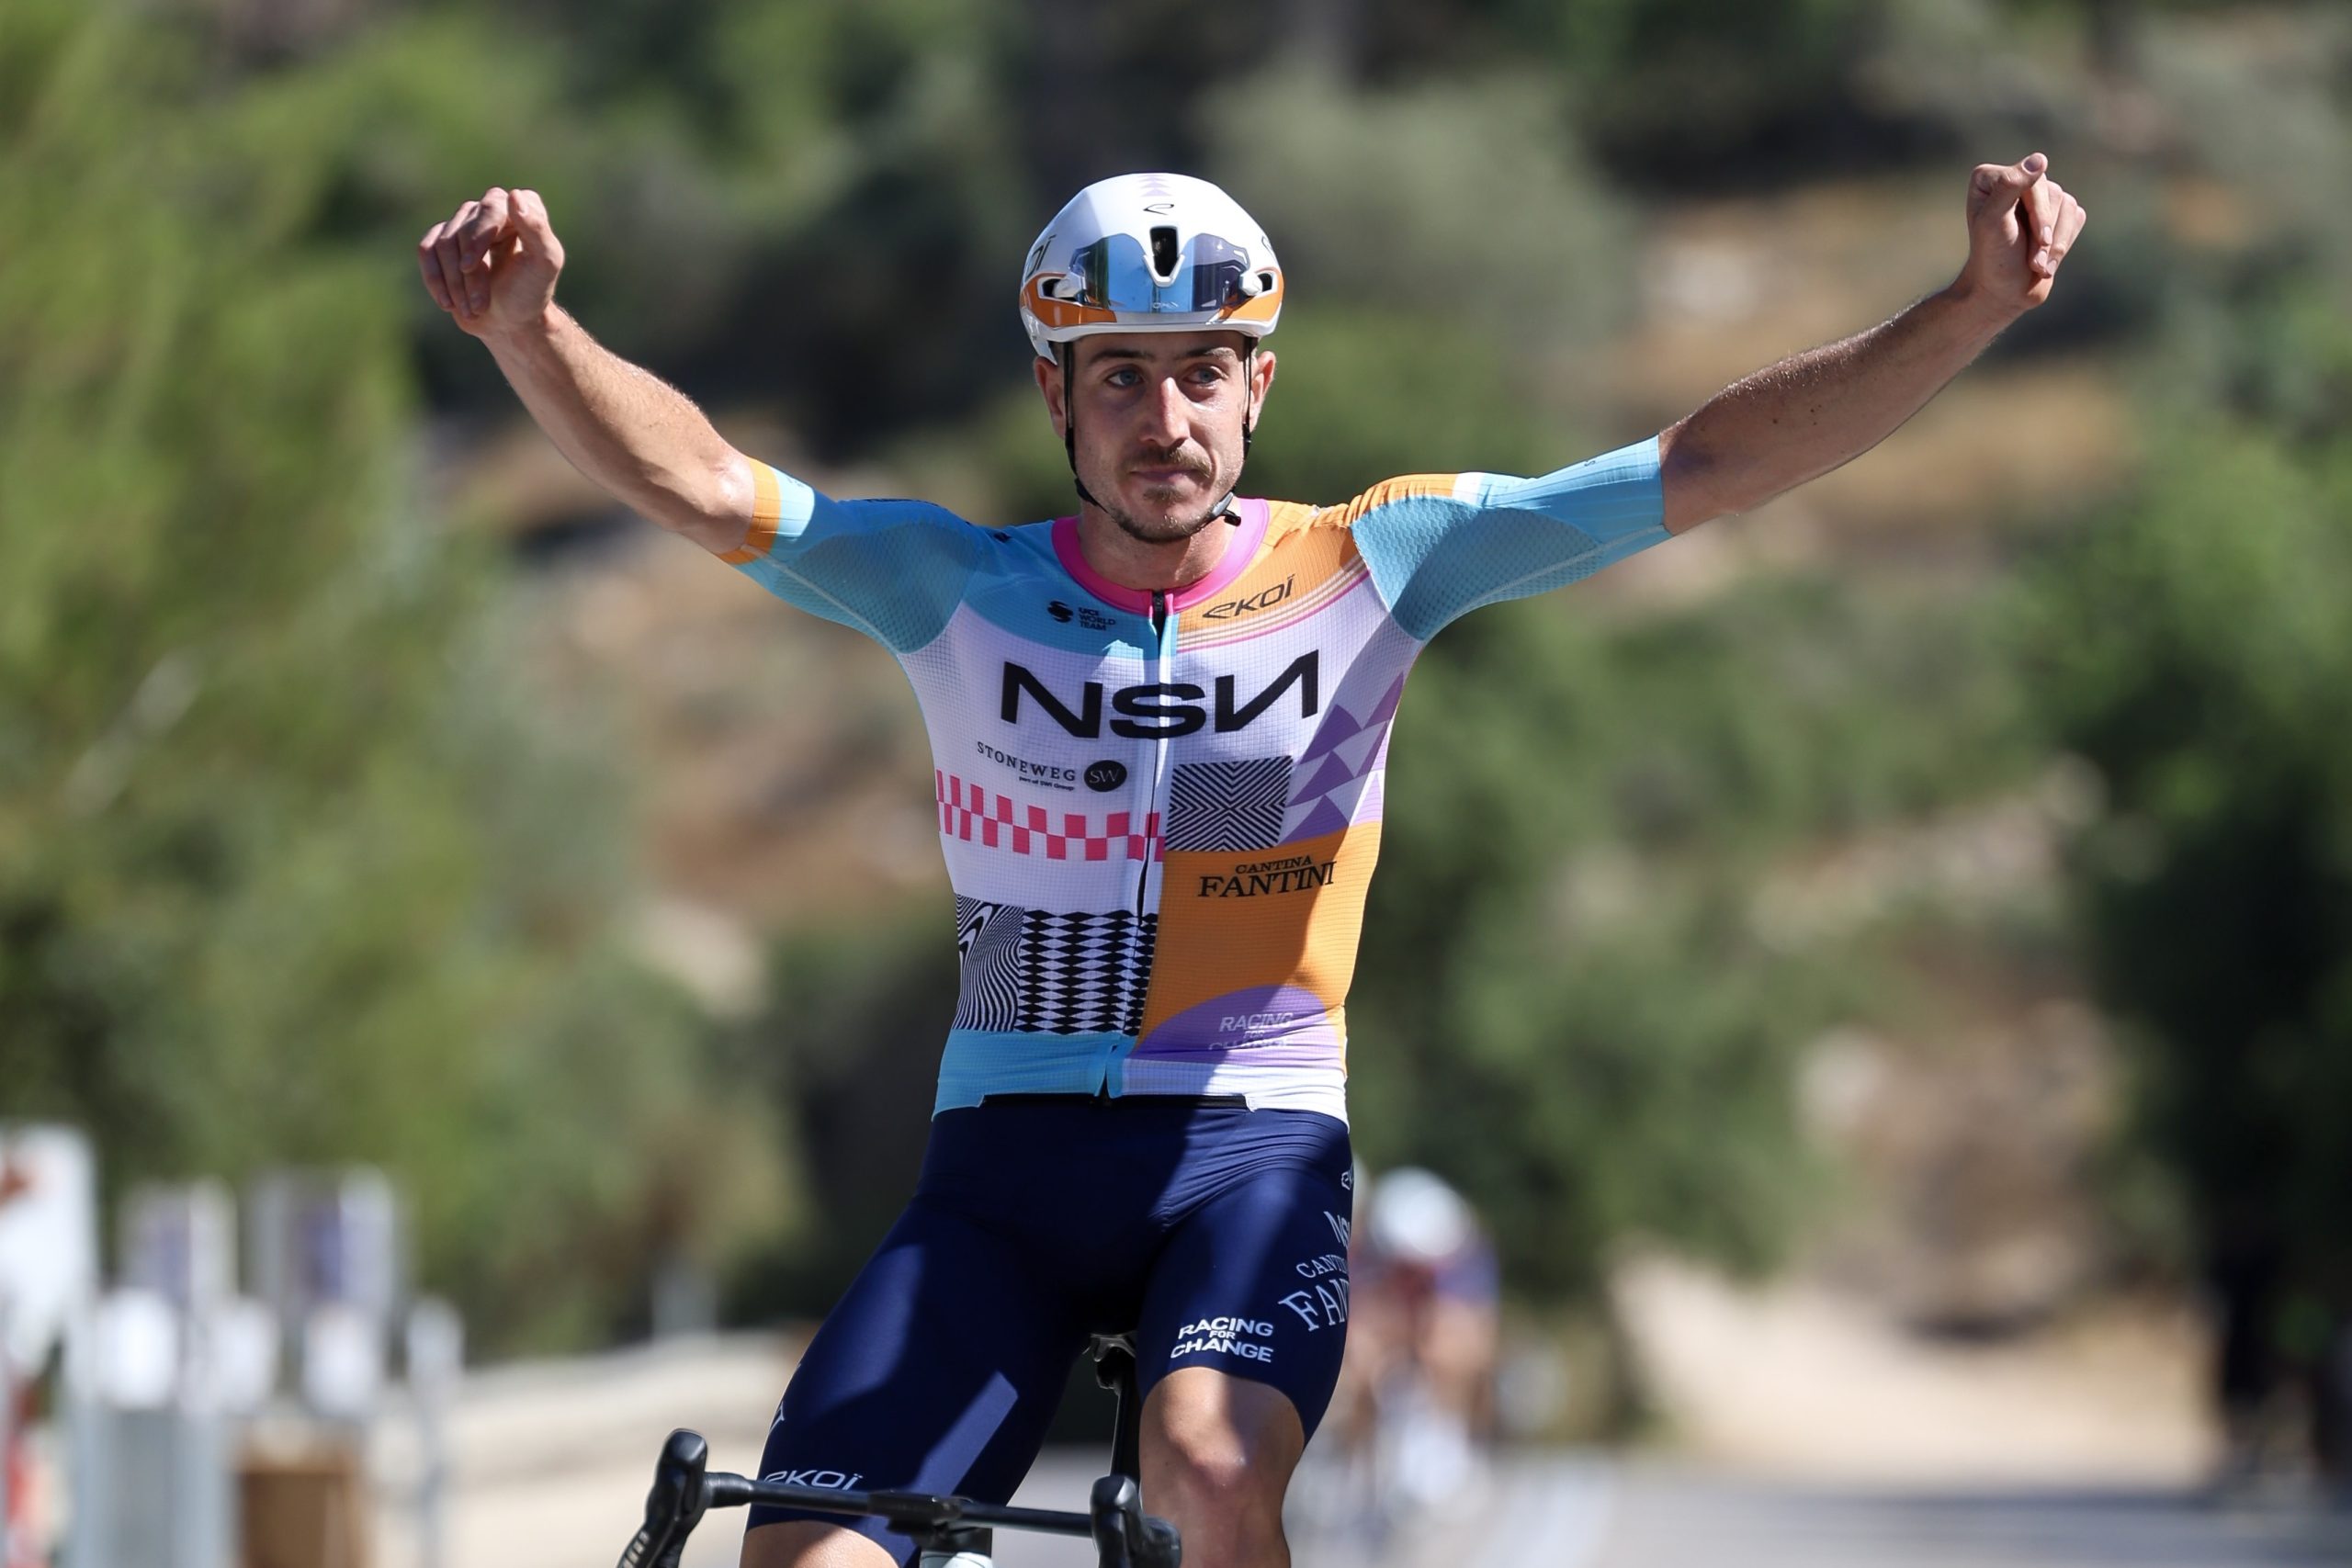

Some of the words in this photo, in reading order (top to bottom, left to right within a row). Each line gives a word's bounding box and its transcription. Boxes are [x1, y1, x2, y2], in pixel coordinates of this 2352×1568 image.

[1078, 607, 1099, 616] UCI
[1079, 613, 1116, 626] WORLD
[1080, 620, 1107, 631] TEAM
[977, 741, 1076, 782] STONEWEG
[1089, 768, 1120, 784] SW
[1235, 854, 1313, 874] CANTINA
[1197, 861, 1338, 897] FANTINI
[1218, 1012, 1294, 1032] RACING
[1323, 1211, 1351, 1250] NS
[1178, 1316, 1274, 1339] RACING
[1209, 1330, 1236, 1339] FOR
[1170, 1337, 1274, 1363] CHANGE
